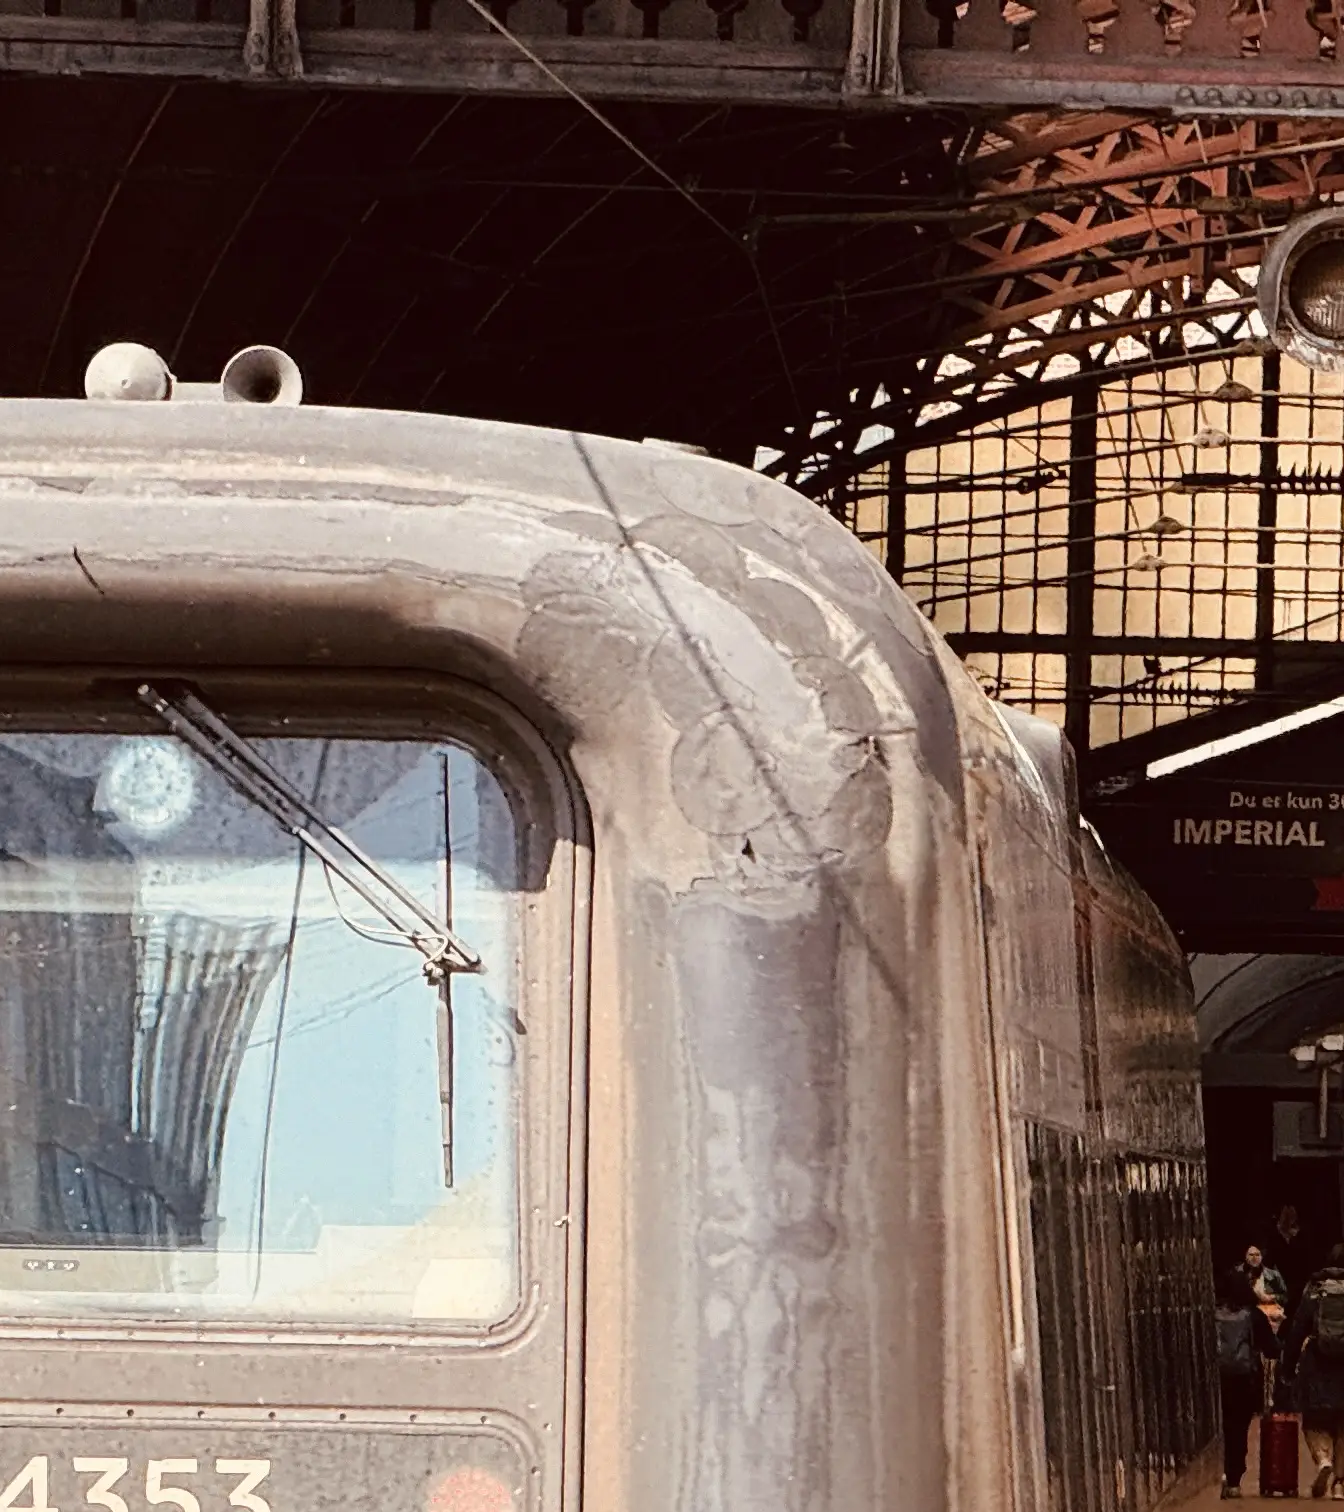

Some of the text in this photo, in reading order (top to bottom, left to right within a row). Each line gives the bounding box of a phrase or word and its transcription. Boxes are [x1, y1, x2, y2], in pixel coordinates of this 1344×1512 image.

[1229, 791, 1256, 808] Du
[1262, 796, 1285, 809] er
[1287, 792, 1324, 810] kun
[1173, 818, 1325, 848] IMPERIAL
